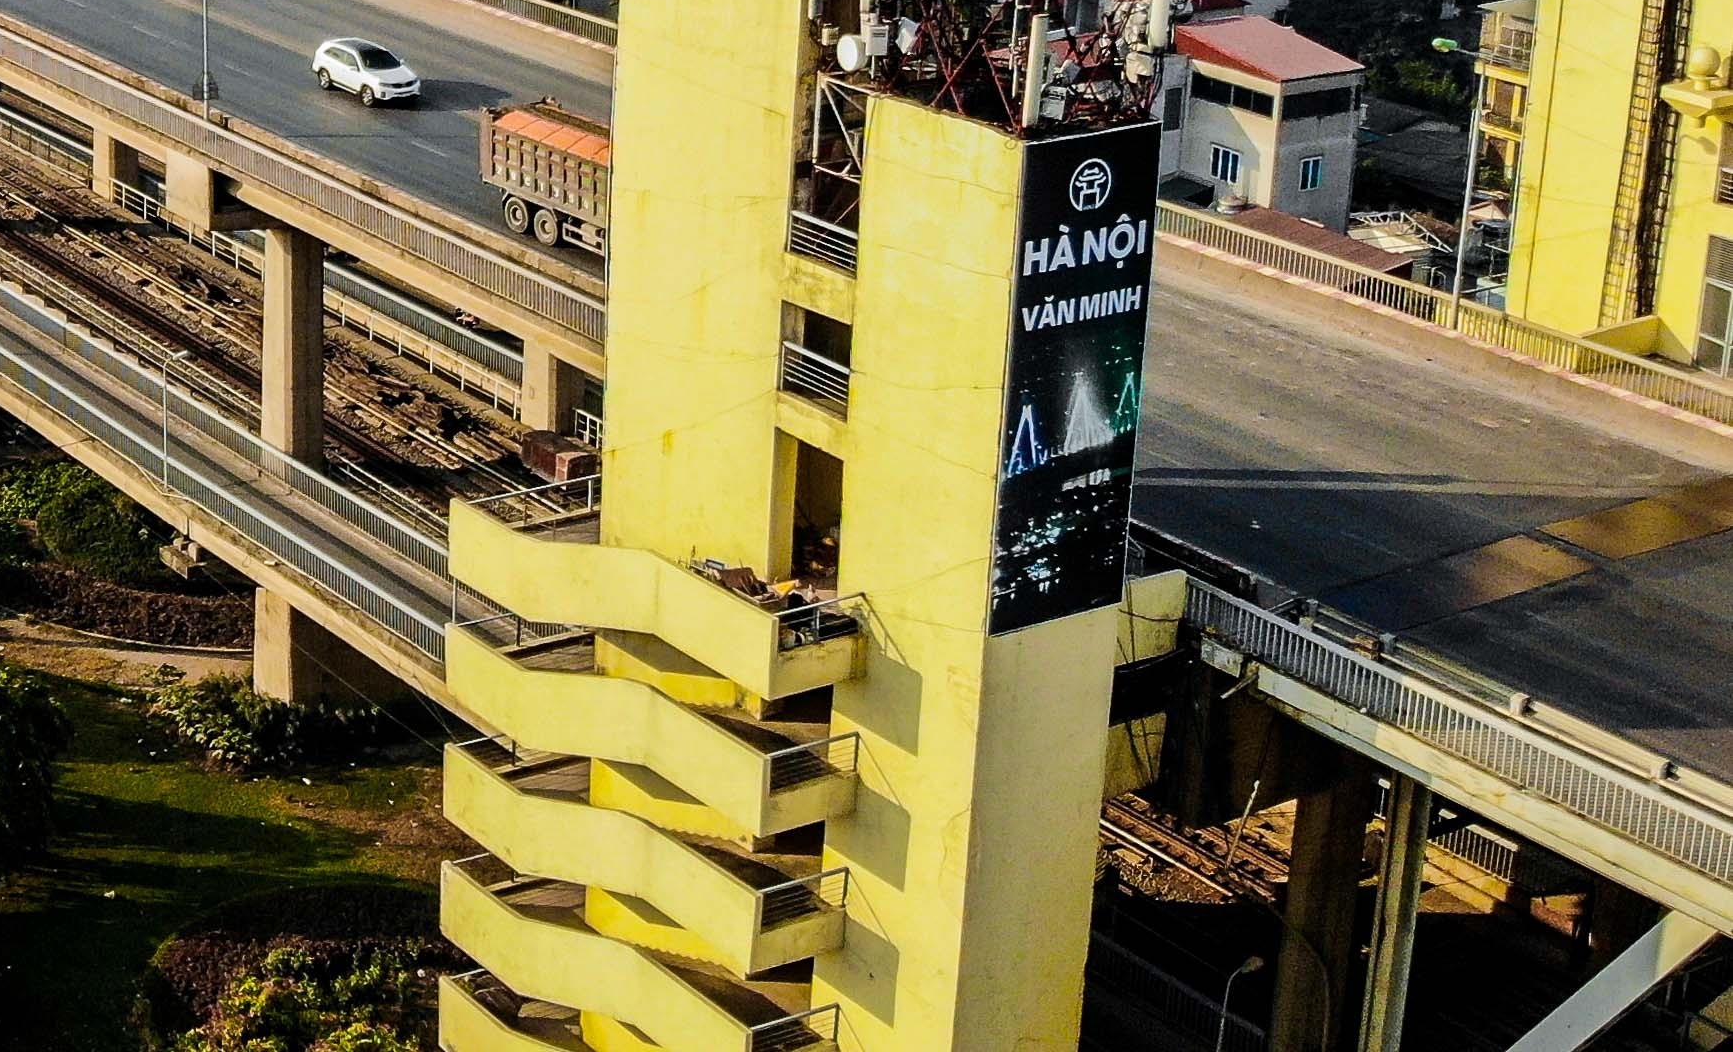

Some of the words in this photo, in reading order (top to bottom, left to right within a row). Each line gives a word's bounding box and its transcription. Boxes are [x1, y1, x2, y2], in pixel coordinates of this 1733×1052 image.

[1022, 224, 1076, 277] HÀ
[1081, 213, 1147, 269] NỘI
[1021, 294, 1076, 332] VĂN
[1078, 284, 1142, 322] MINH
